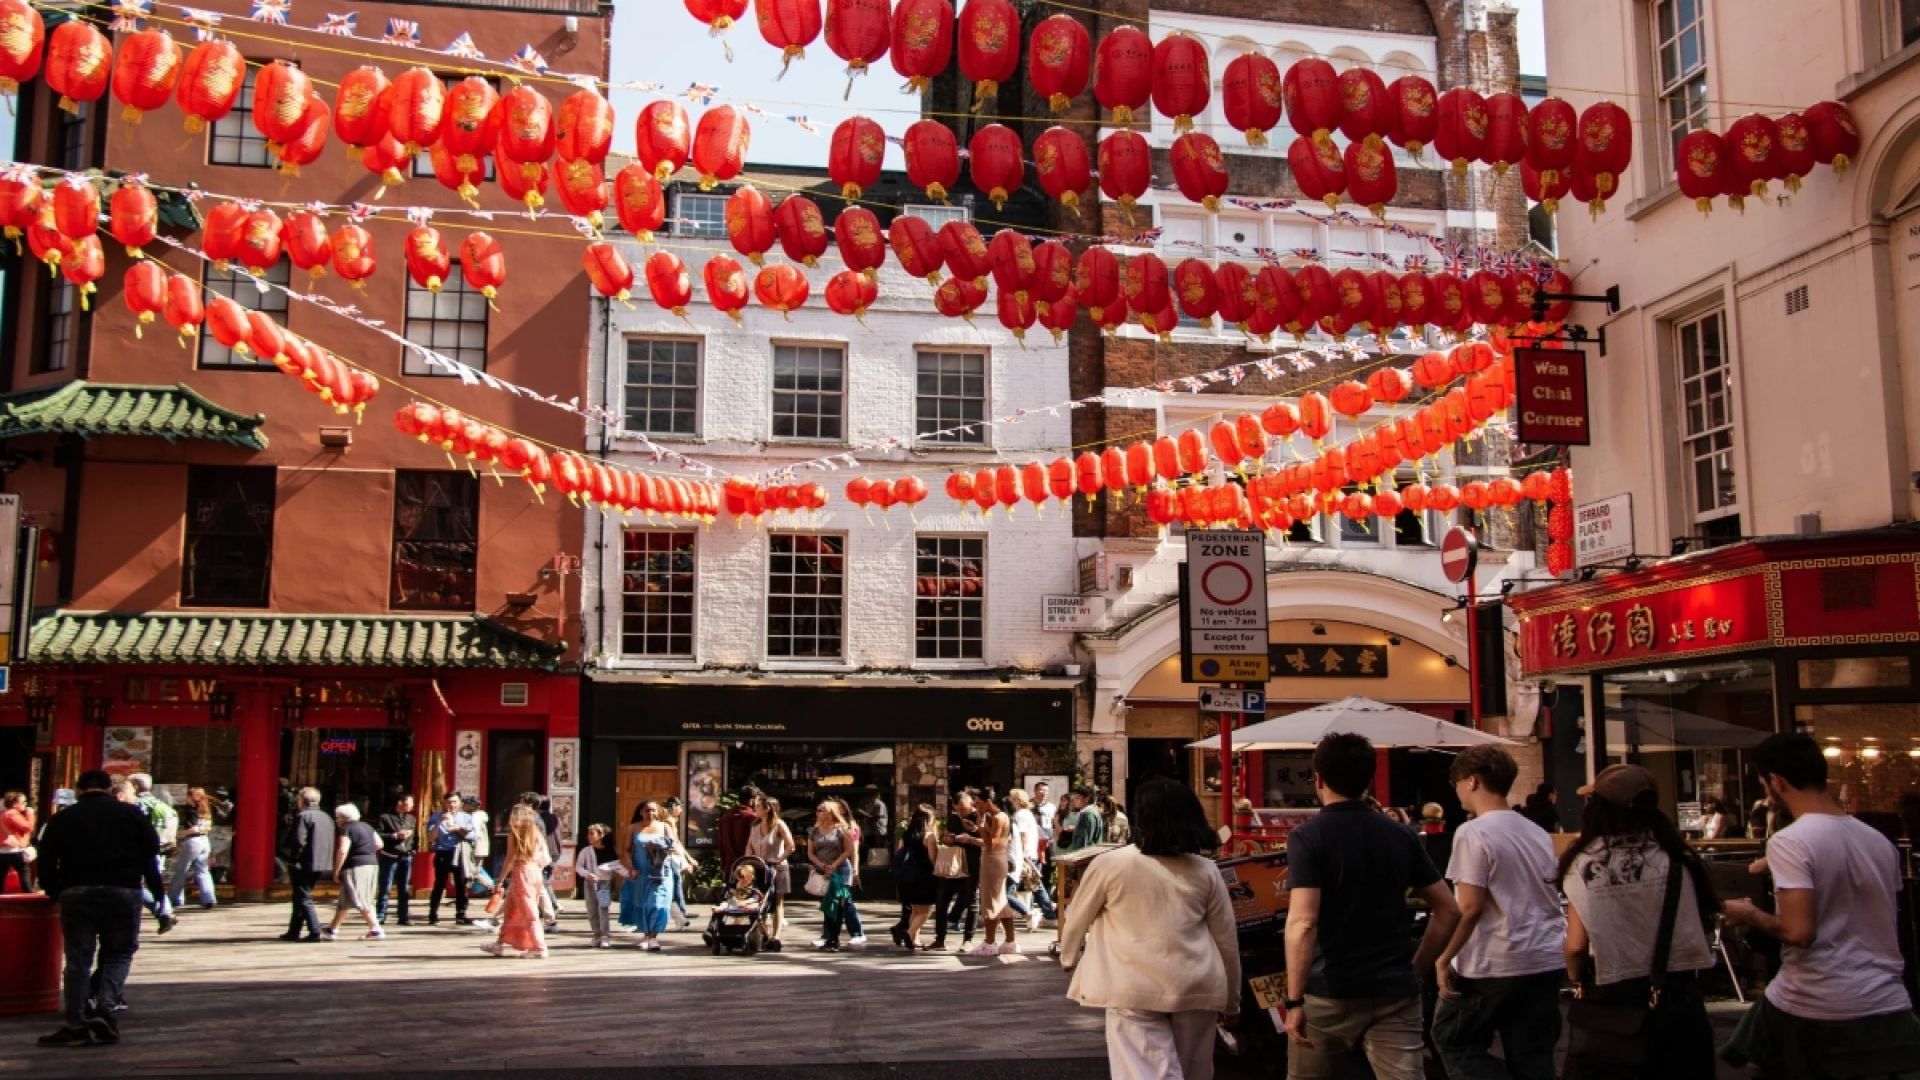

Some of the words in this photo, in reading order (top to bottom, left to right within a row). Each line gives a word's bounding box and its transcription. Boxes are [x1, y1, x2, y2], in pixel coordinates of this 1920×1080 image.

[1534, 361, 1569, 375] Wan
[1532, 386, 1572, 401] Chai
[1523, 411, 1584, 427] Corner
[1191, 533, 1260, 543] PEDESTRIAN
[1201, 545, 1250, 557] ZONE
[1200, 608, 1214, 616] No
[1217, 608, 1257, 616] vehicles
[1203, 633, 1238, 642] Except
[1241, 633, 1255, 641] for
[1213, 643, 1246, 651] access
[1229, 659, 1241, 667] At
[1243, 661, 1262, 669] any
[1270, 647, 1379, 673] 味食堂
[1234, 668, 1257, 677] time
[127, 680, 218, 701] NEW
[967, 718, 1004, 731] Oita
[320, 741, 356, 752] OPEN
[1252, 973, 1288, 993] LM2
